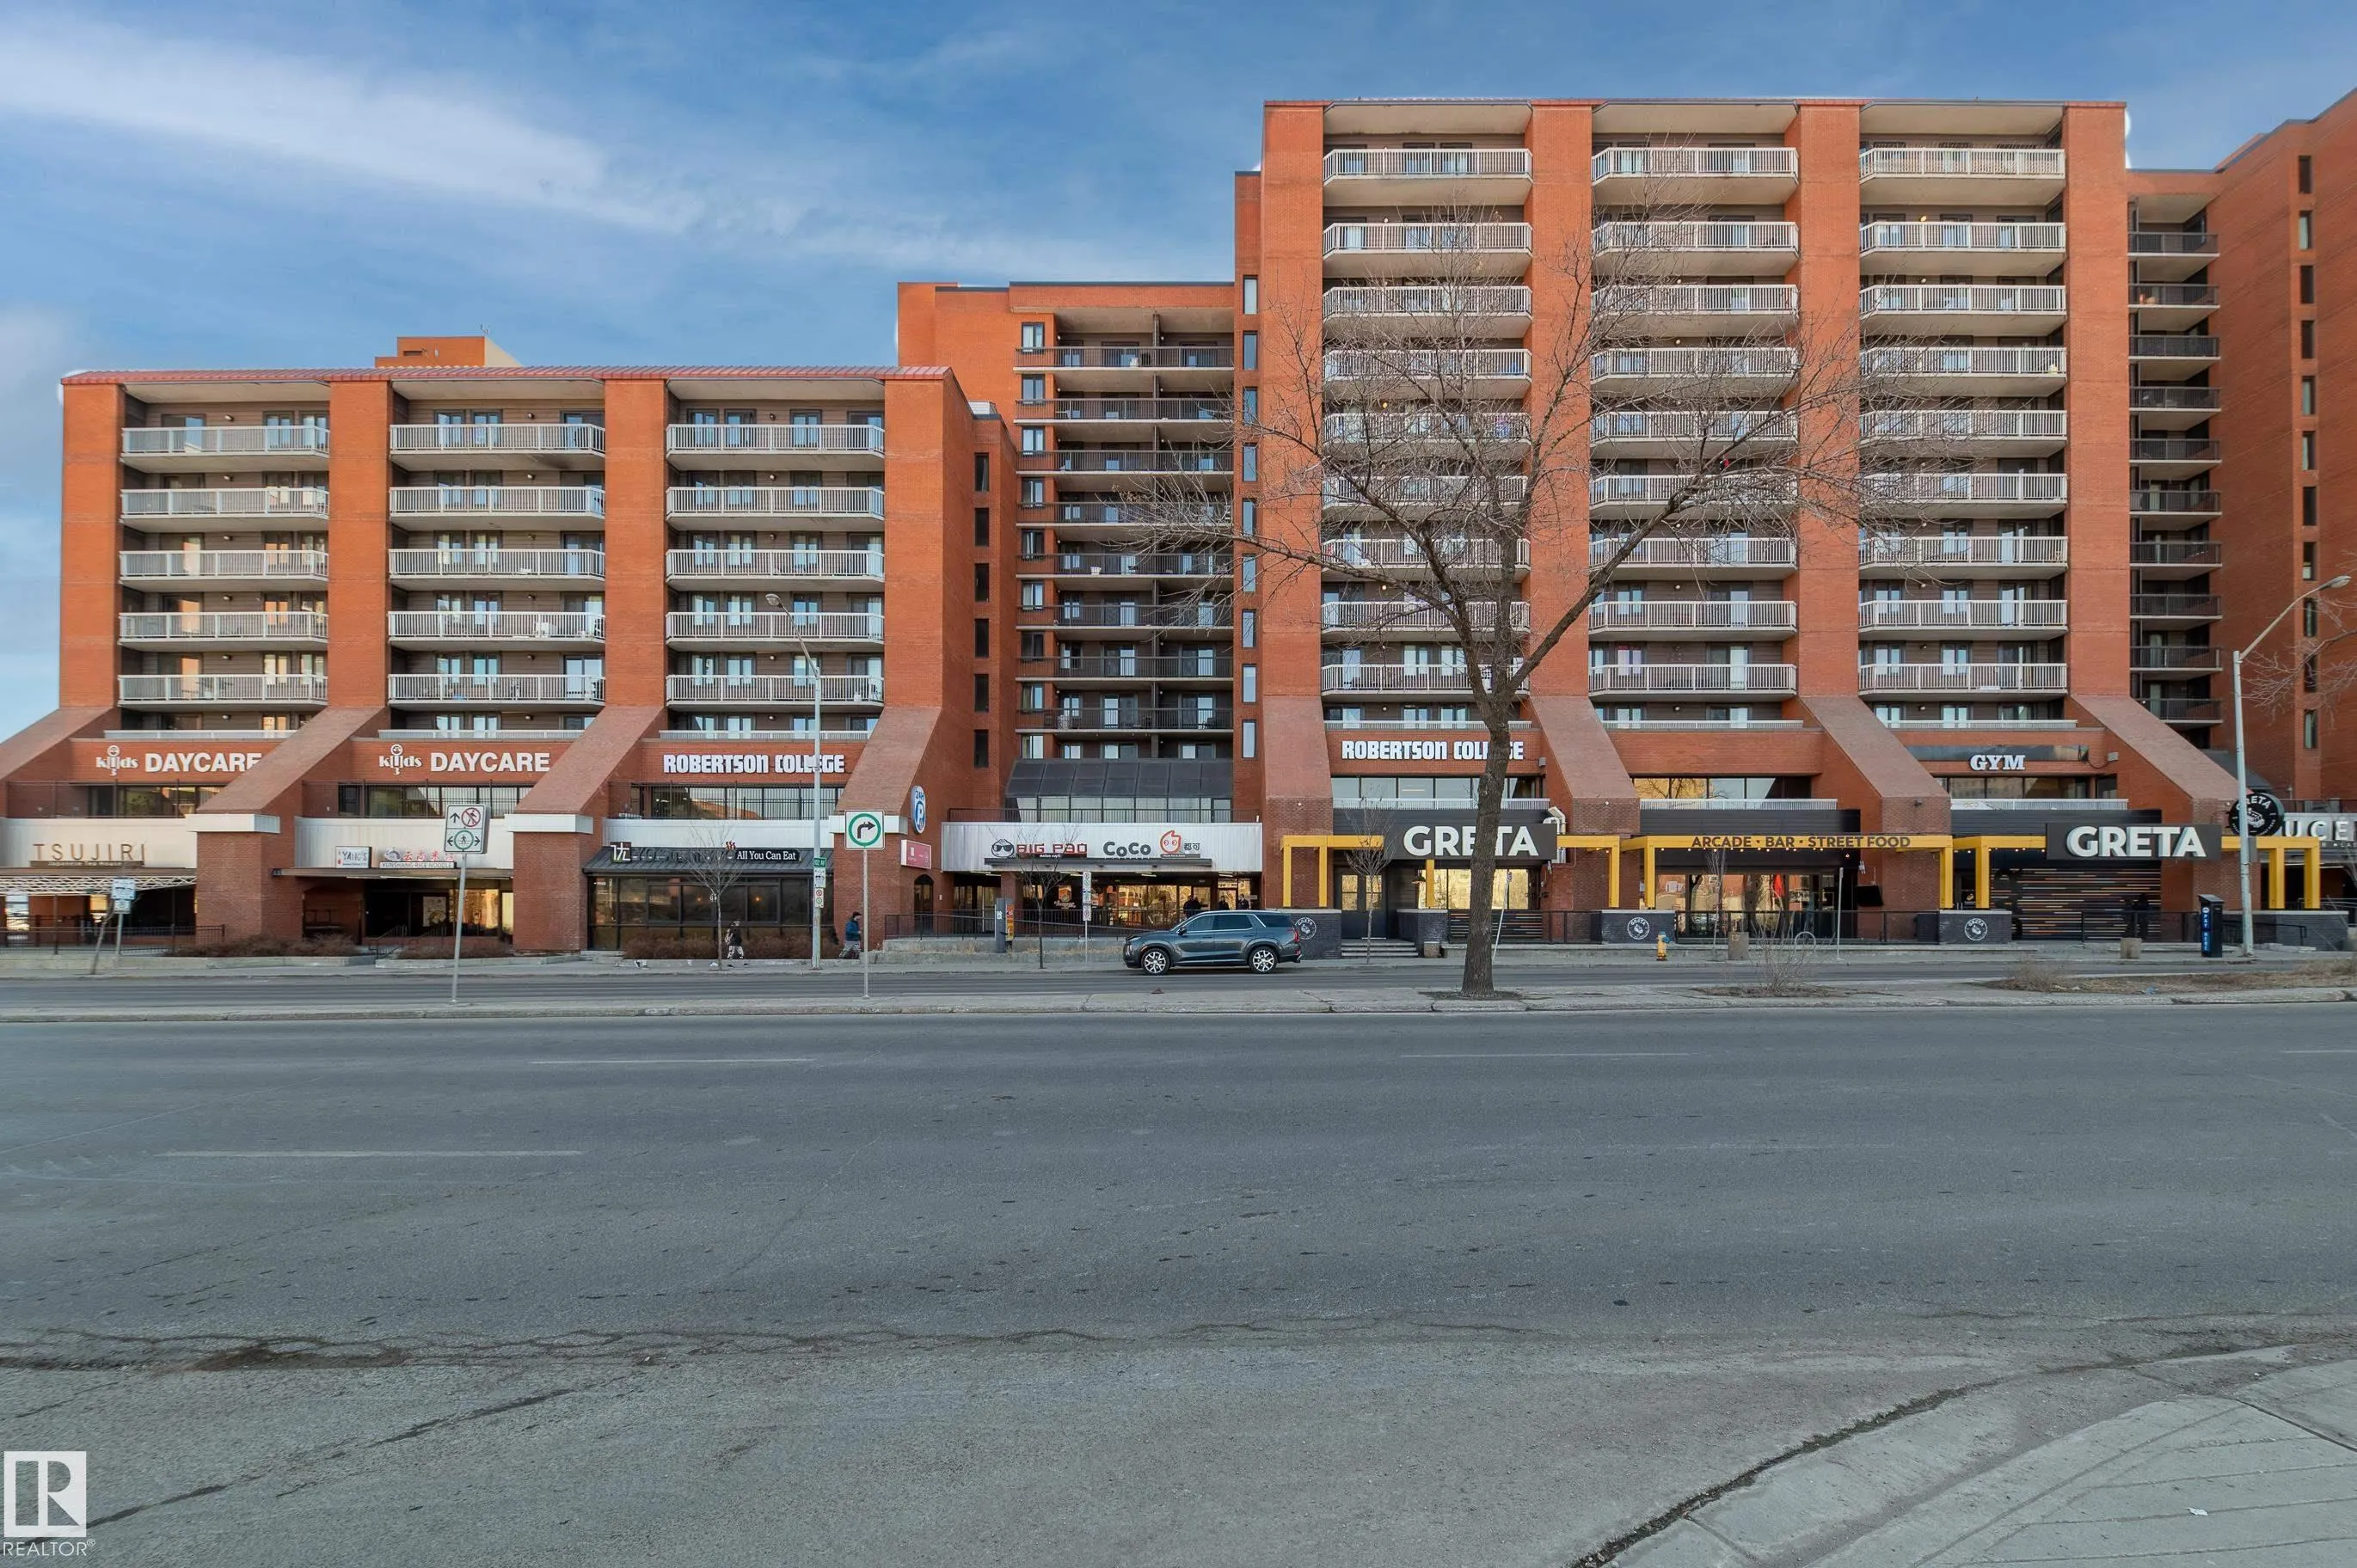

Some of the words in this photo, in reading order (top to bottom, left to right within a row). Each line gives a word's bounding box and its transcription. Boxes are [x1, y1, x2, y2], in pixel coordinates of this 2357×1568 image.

[1341, 740, 1448, 760] ROBERTSON
[1453, 741, 1524, 760] COLLE
[431, 752, 550, 772] DAYCARE
[663, 754, 769, 773] ROBERTSON
[775, 754, 844, 773] COLLGE
[1969, 755, 2026, 771] GYM
[1016, 843, 1045, 854] BIG
[1103, 841, 1151, 857] CoCo
[1403, 825, 1539, 857] GRETA
[1691, 836, 1752, 848] ARCADE
[1765, 836, 1795, 848] BAR
[1808, 836, 1864, 848] STREET
[1867, 836, 1911, 848] FOOD
[2066, 826, 2207, 858] GRETA
[33, 843, 145, 861] TSUJIRI
[737, 850, 748, 860] All
[749, 850, 764, 860] You
[765, 850, 782, 860] Can
[783, 850, 796, 860] Eat
